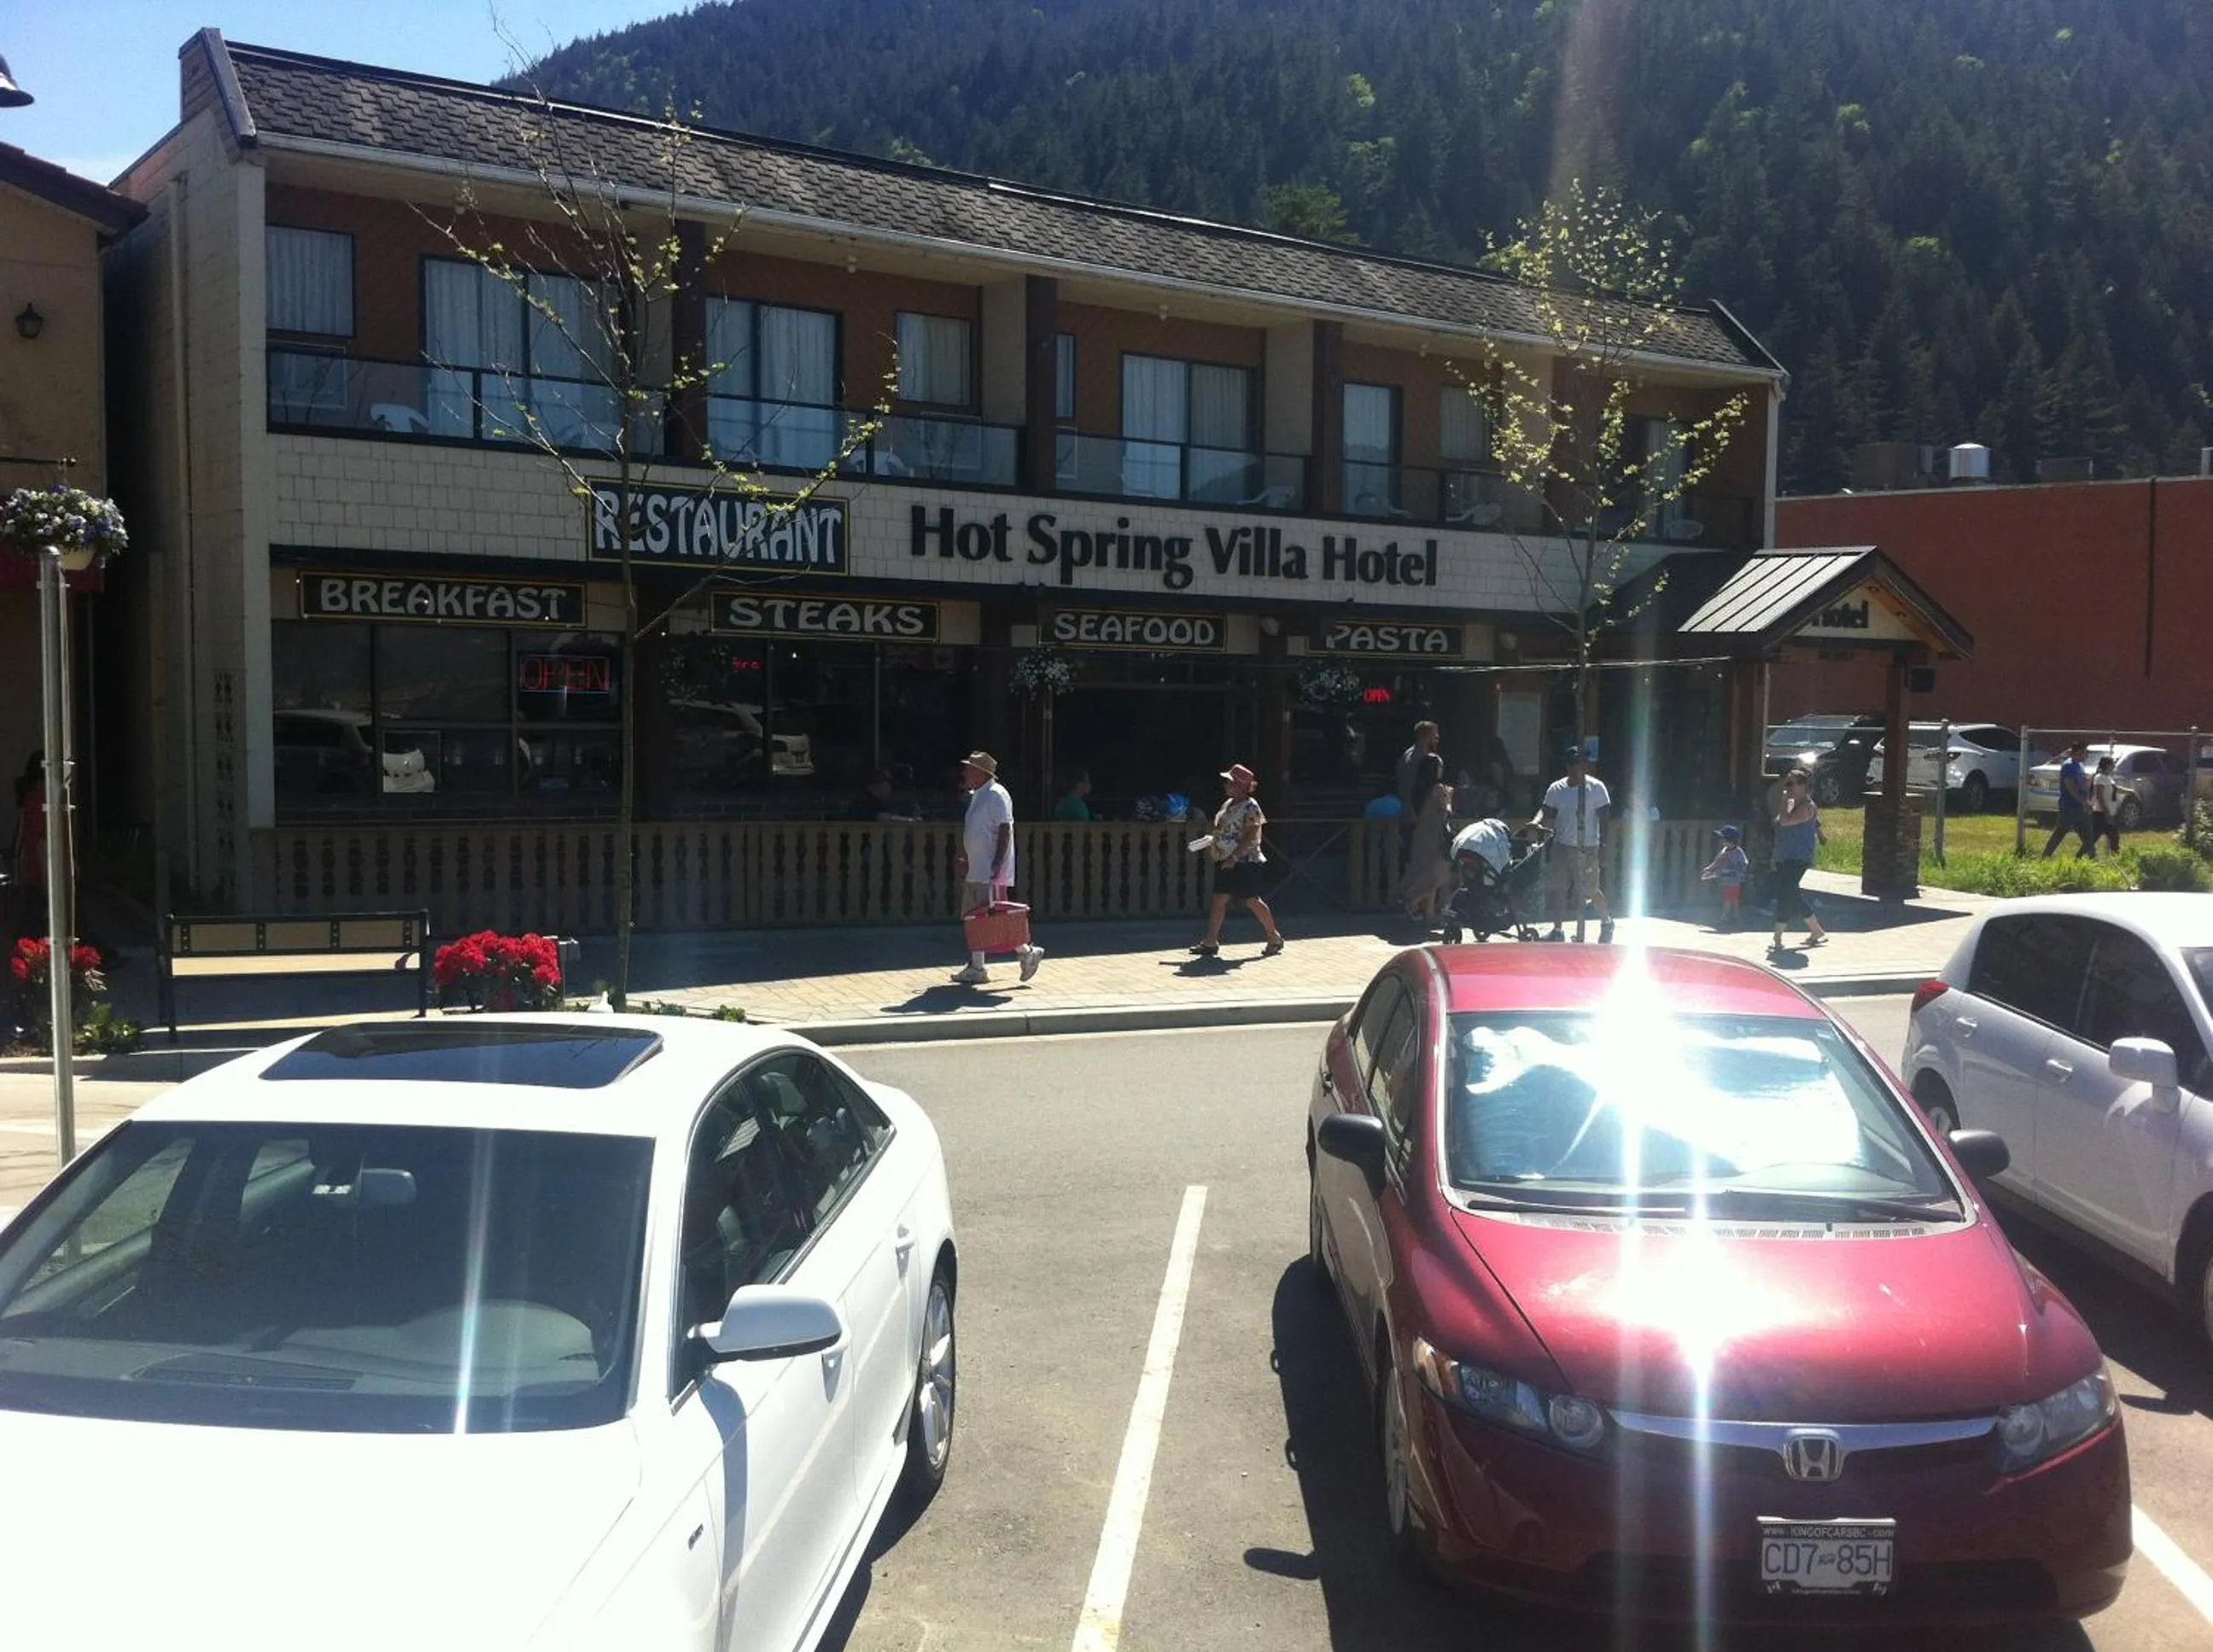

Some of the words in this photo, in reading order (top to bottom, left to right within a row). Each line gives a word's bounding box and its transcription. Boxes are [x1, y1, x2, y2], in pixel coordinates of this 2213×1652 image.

[593, 489, 844, 564] RESTAURANT
[910, 505, 1013, 563] Hot
[1026, 514, 1194, 590] Spring
[1205, 525, 1309, 581] Villa
[1323, 535, 1437, 587] Hotel
[319, 576, 567, 622] BREAKFAST
[728, 596, 925, 637] STEAKS
[1053, 609, 1217, 646] SEAFOOD
[1325, 624, 1449, 654] PASTA
[522, 657, 610, 691] OPEN
